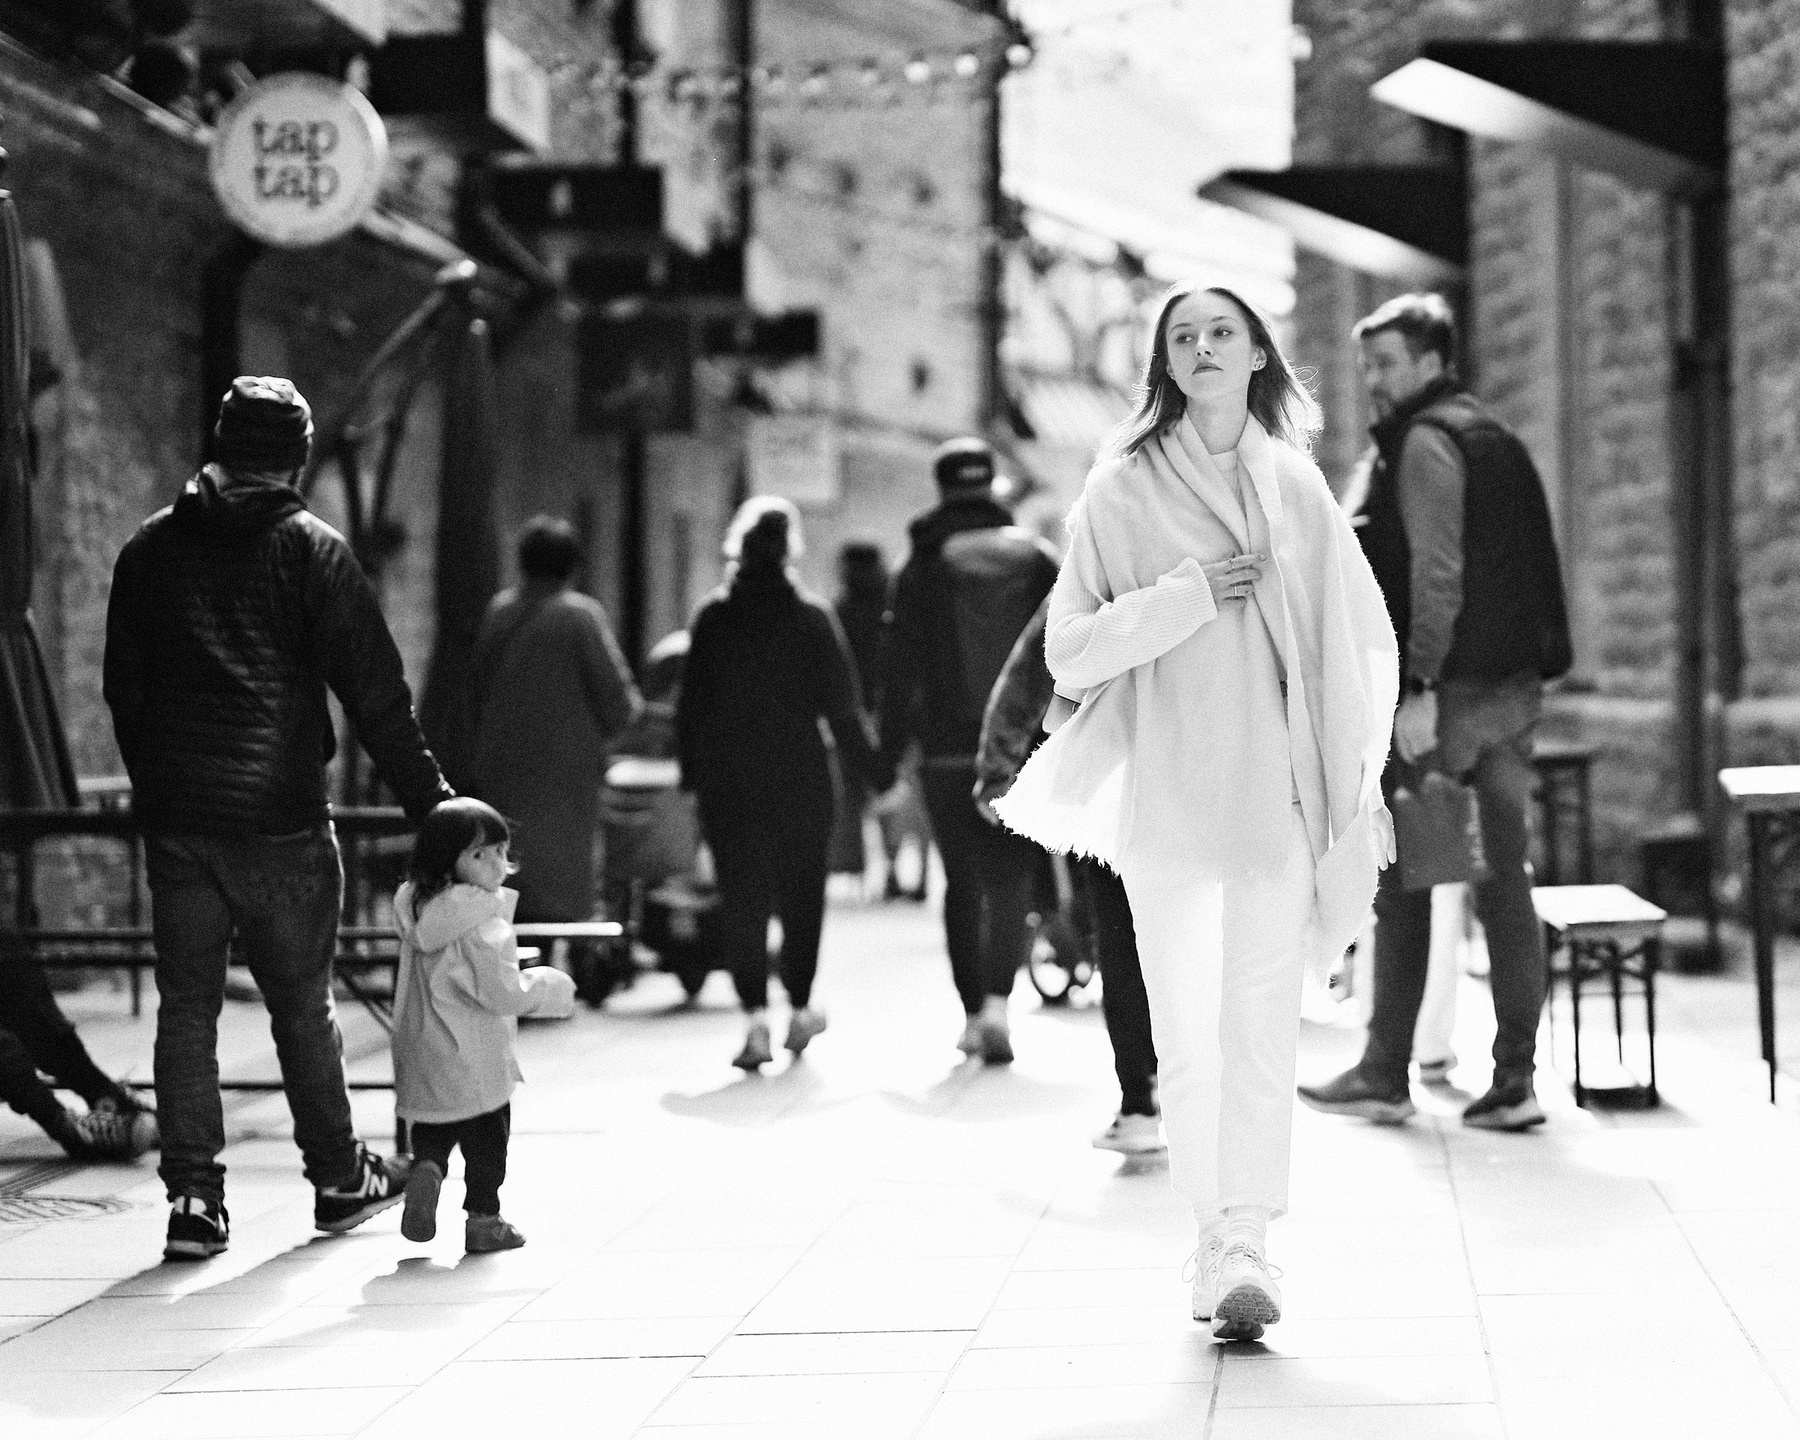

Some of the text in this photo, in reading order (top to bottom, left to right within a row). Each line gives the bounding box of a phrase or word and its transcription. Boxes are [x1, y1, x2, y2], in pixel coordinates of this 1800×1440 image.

[253, 116, 339, 162] tap
[253, 164, 340, 208] tap
[368, 1173, 388, 1197] N
